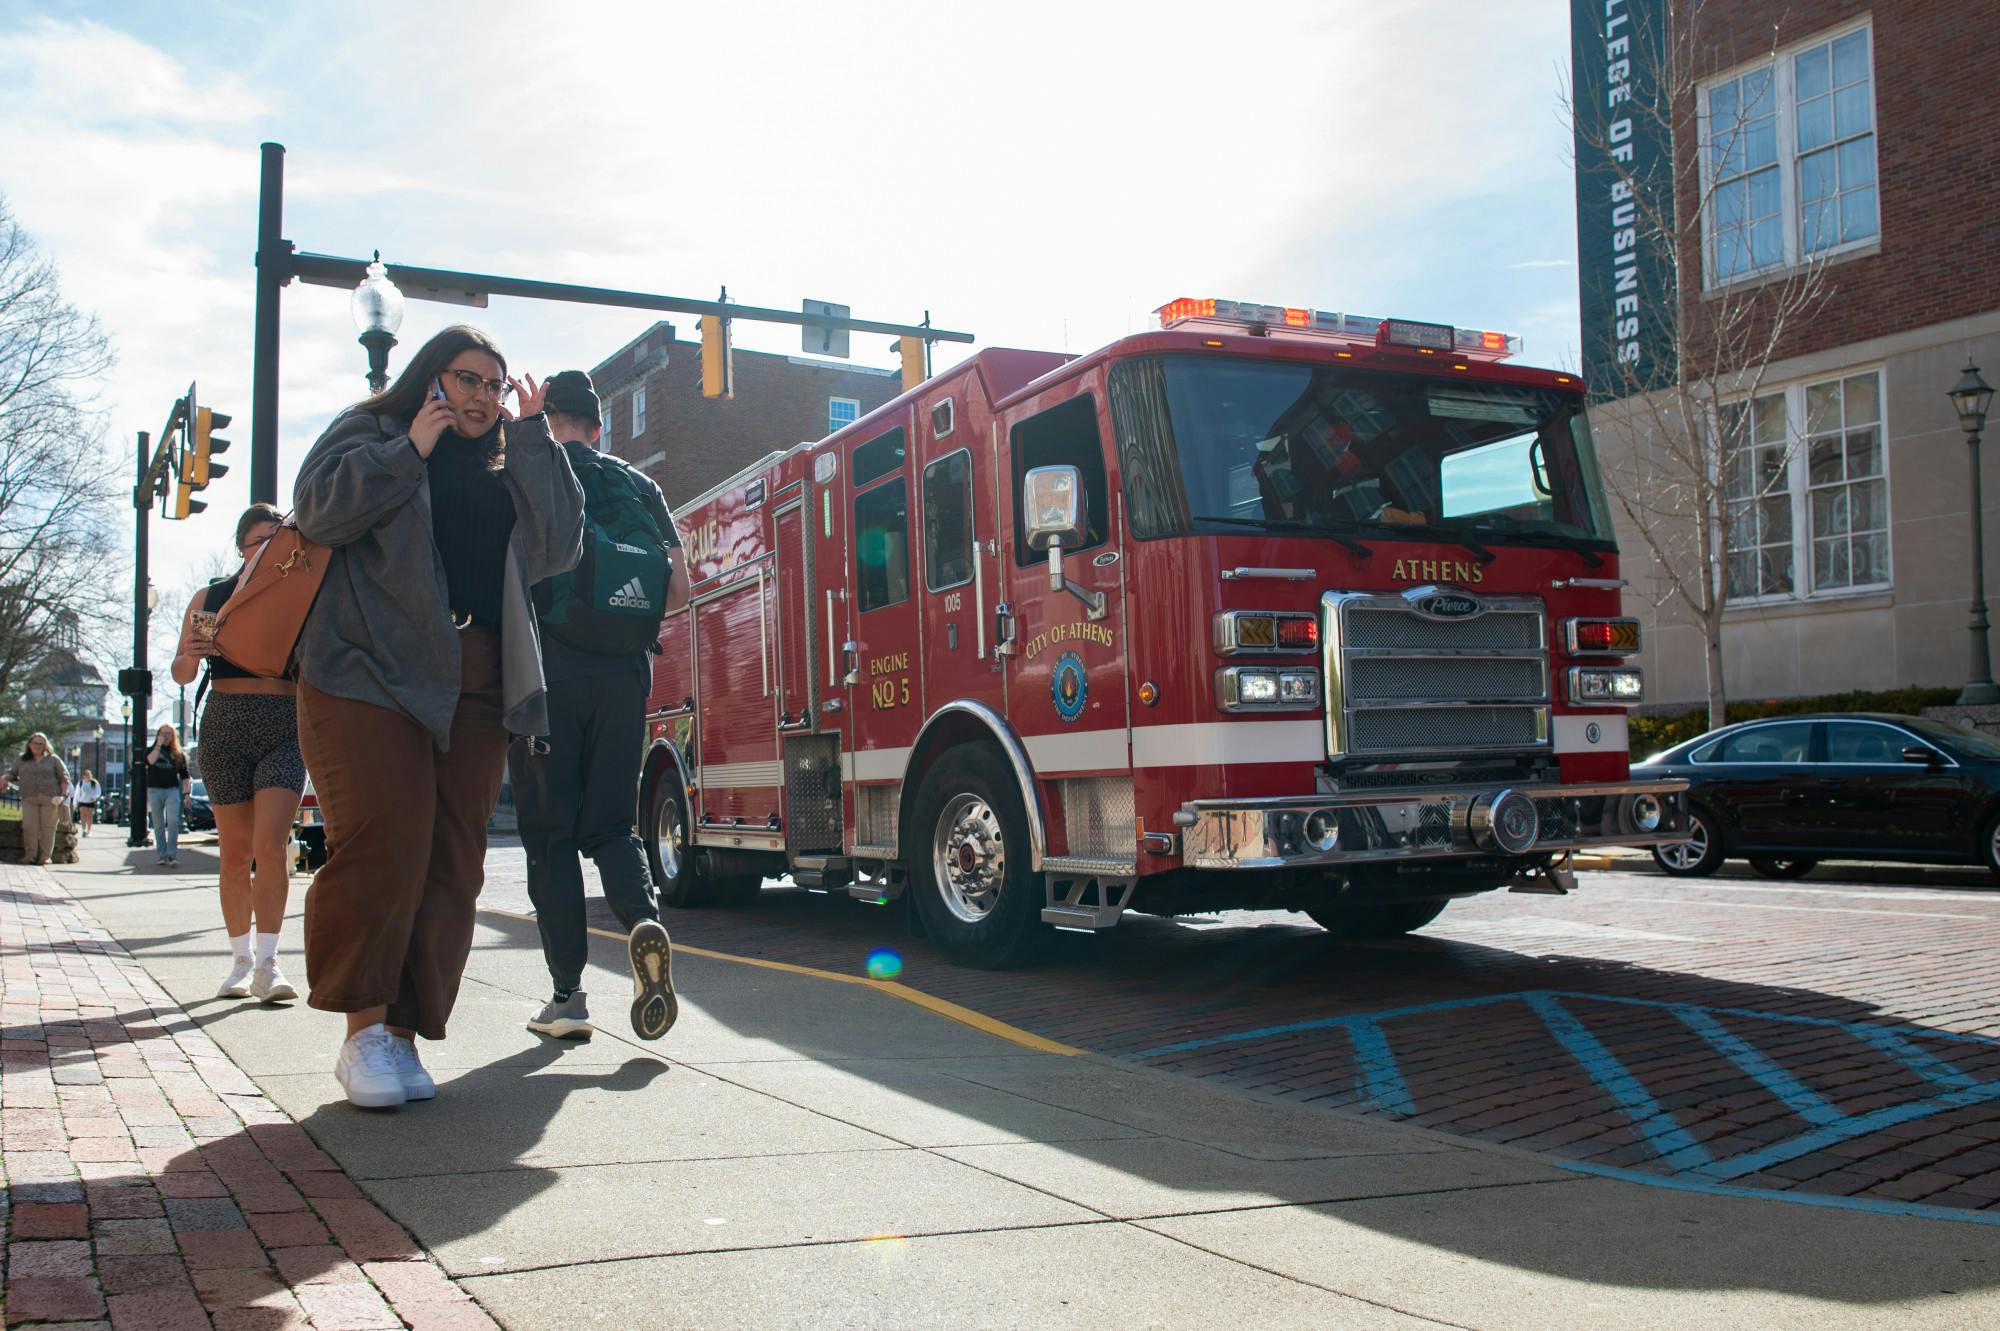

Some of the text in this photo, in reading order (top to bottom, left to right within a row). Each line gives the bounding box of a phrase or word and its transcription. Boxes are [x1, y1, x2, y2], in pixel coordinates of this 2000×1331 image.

[1610, 118, 1633, 162] OF
[1612, 178, 1640, 364] BUSINESS
[1392, 559, 1483, 583] ATHENS
[609, 595, 651, 609] adidas
[944, 592, 961, 613] 1005
[1430, 596, 1471, 613] Pierce
[1025, 622, 1113, 660] CITY OF ATHENS
[871, 652, 908, 676] ENGINE
[901, 678, 910, 705] 5
